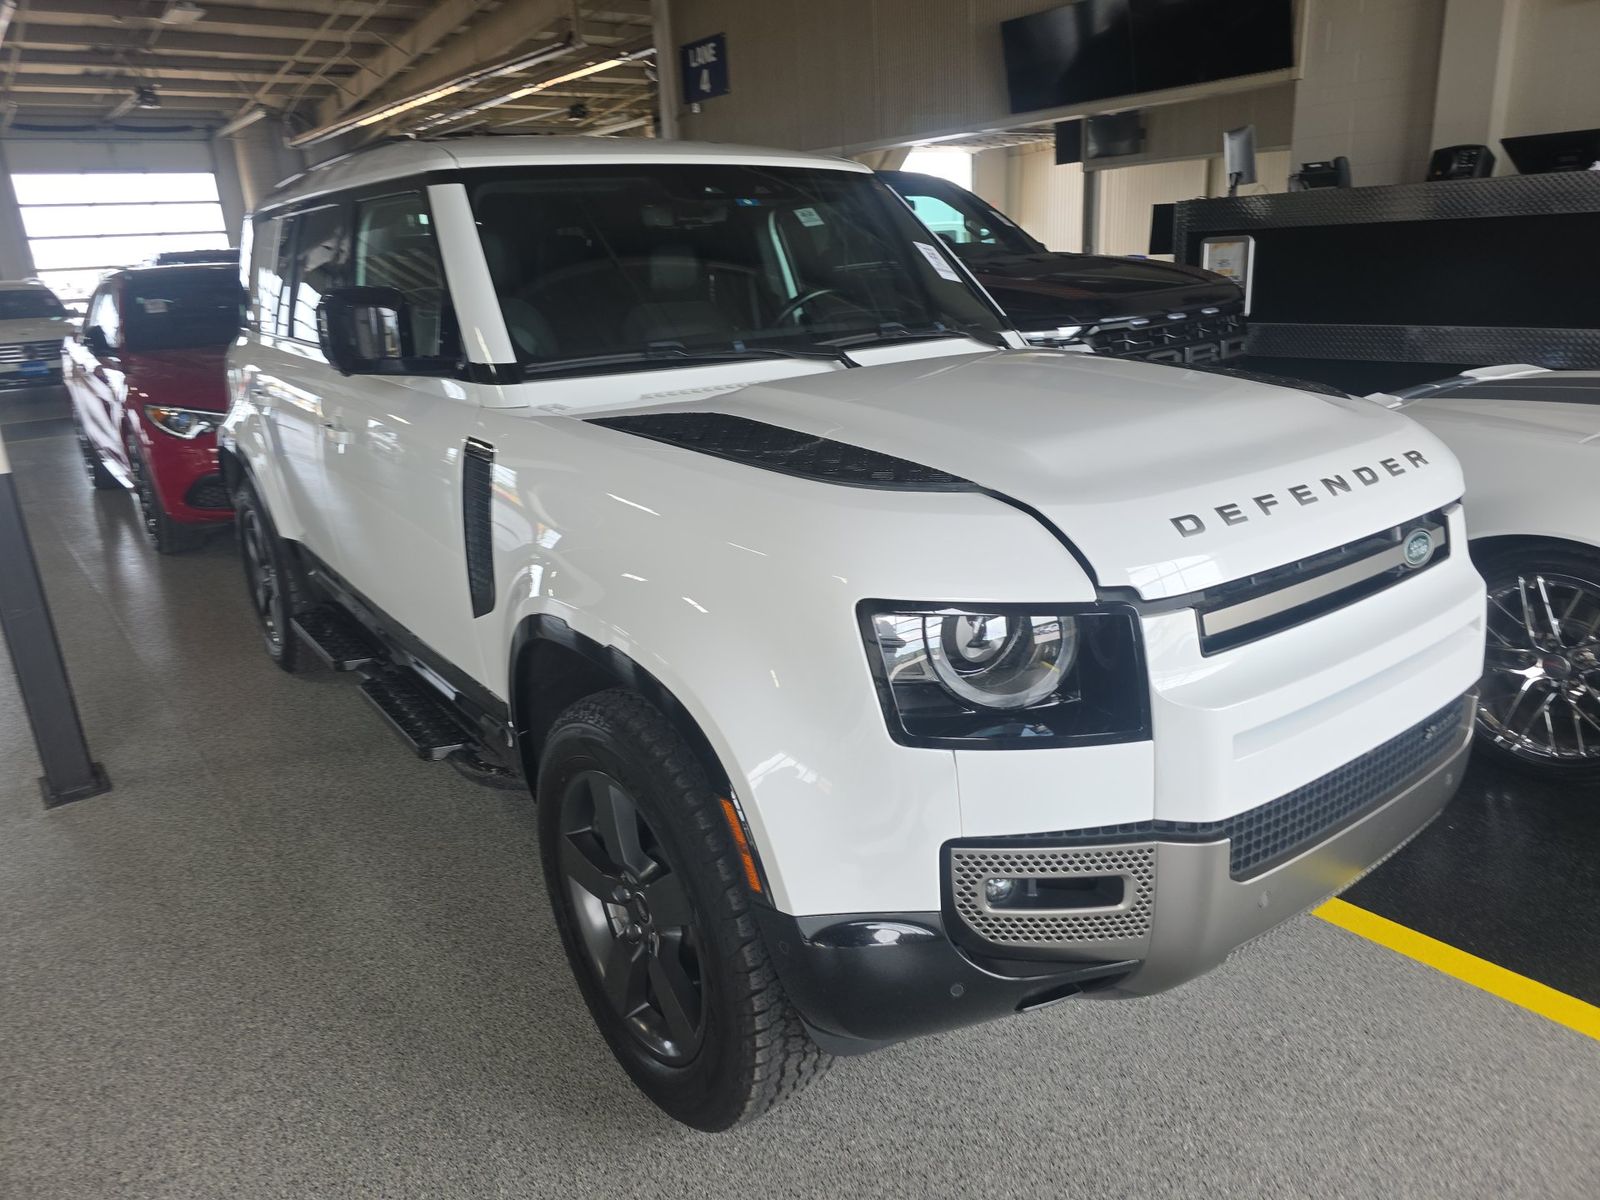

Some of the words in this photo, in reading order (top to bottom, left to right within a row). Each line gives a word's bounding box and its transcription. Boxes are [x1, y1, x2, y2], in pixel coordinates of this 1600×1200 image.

[688, 42, 717, 68] LANE
[700, 69, 711, 93] 4
[1169, 449, 1429, 538] DEFENDER
